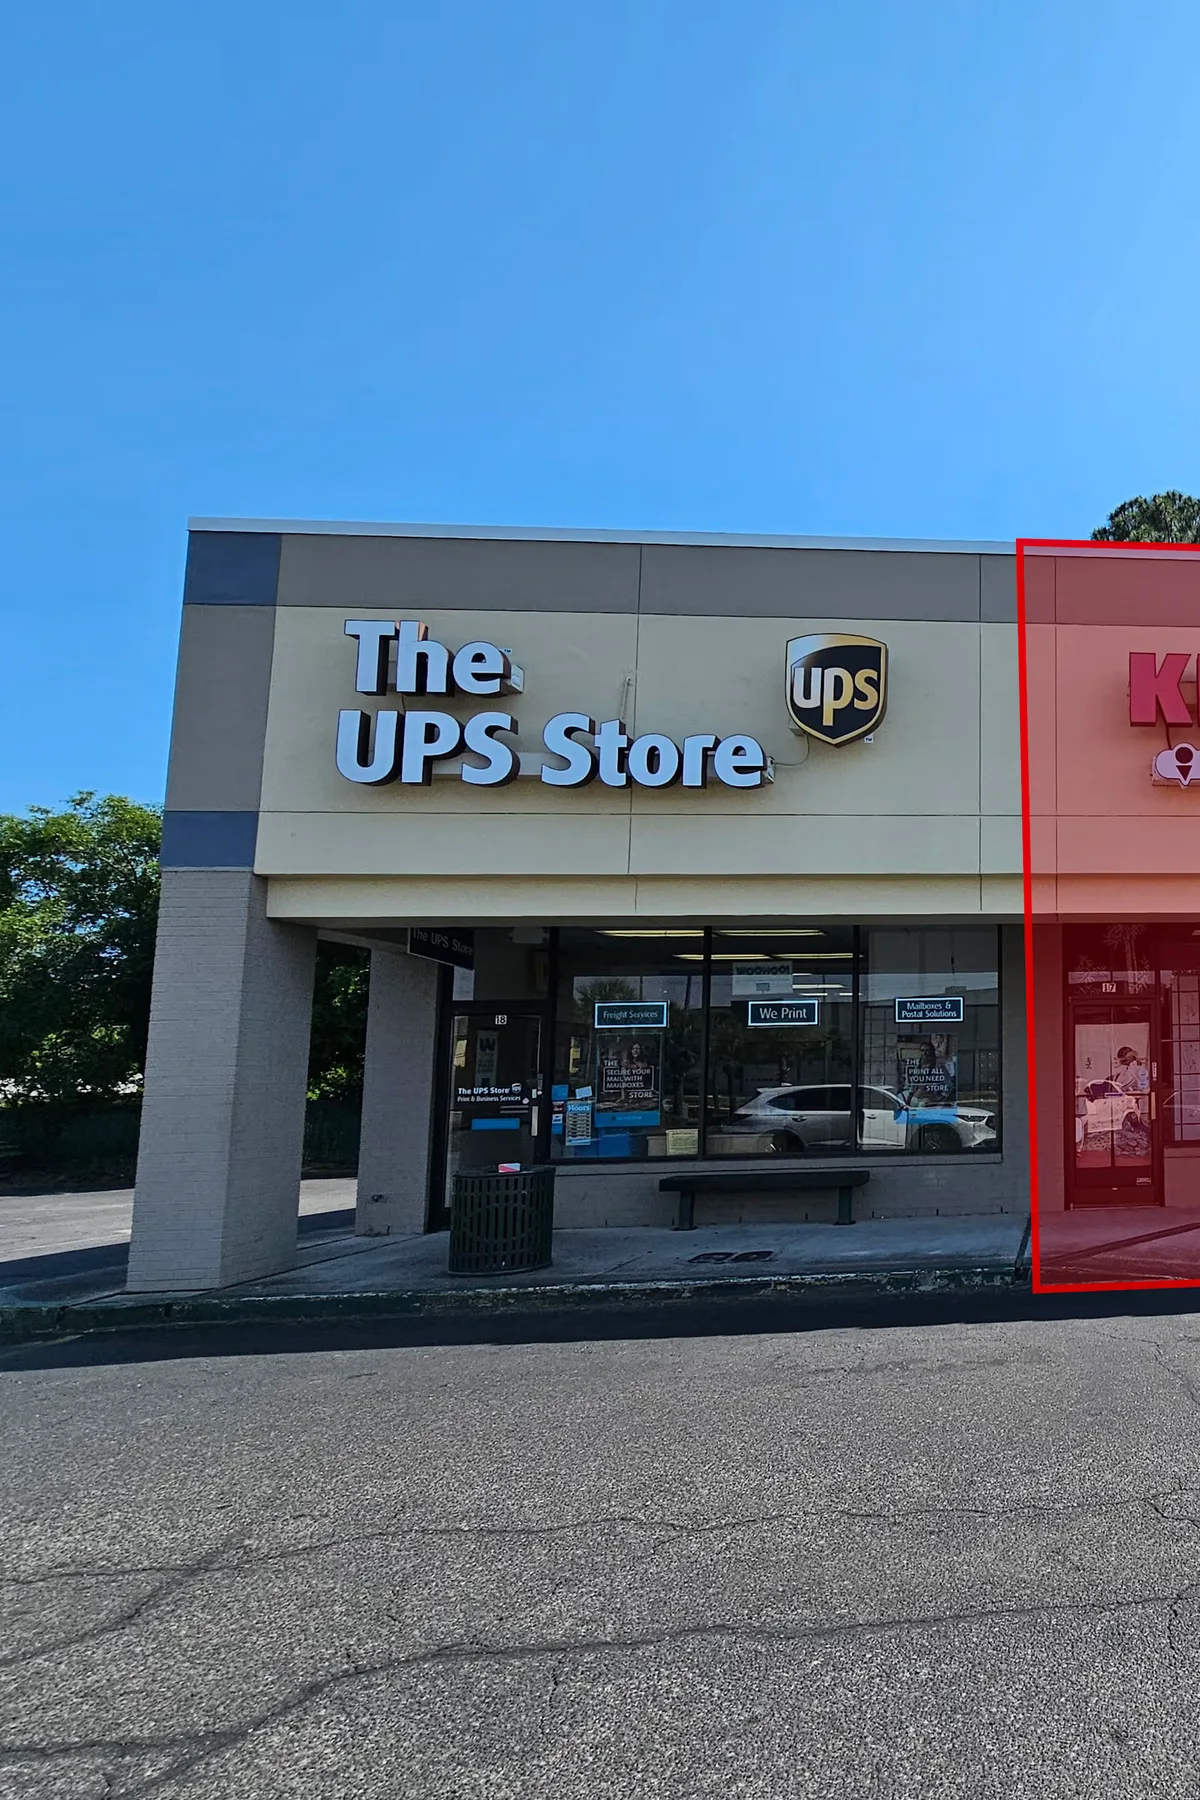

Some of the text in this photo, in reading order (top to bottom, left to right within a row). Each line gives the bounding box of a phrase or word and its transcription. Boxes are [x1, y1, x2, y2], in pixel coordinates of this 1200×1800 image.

[344, 619, 510, 696] The
[793, 667, 879, 726] ups
[335, 709, 766, 789] UPS Store
[431, 932, 449, 948] UPS
[452, 938, 474, 956] Store
[1103, 983, 1116, 992] 17
[907, 1001, 952, 1010] Mailboxes &
[603, 1010, 658, 1020] Freight Services
[759, 1007, 807, 1019] We Print
[902, 1010, 957, 1018] Postal Solutions
[496, 1016, 506, 1024] 18
[629, 1091, 653, 1099] STORE
[568, 1104, 591, 1112] Hours
